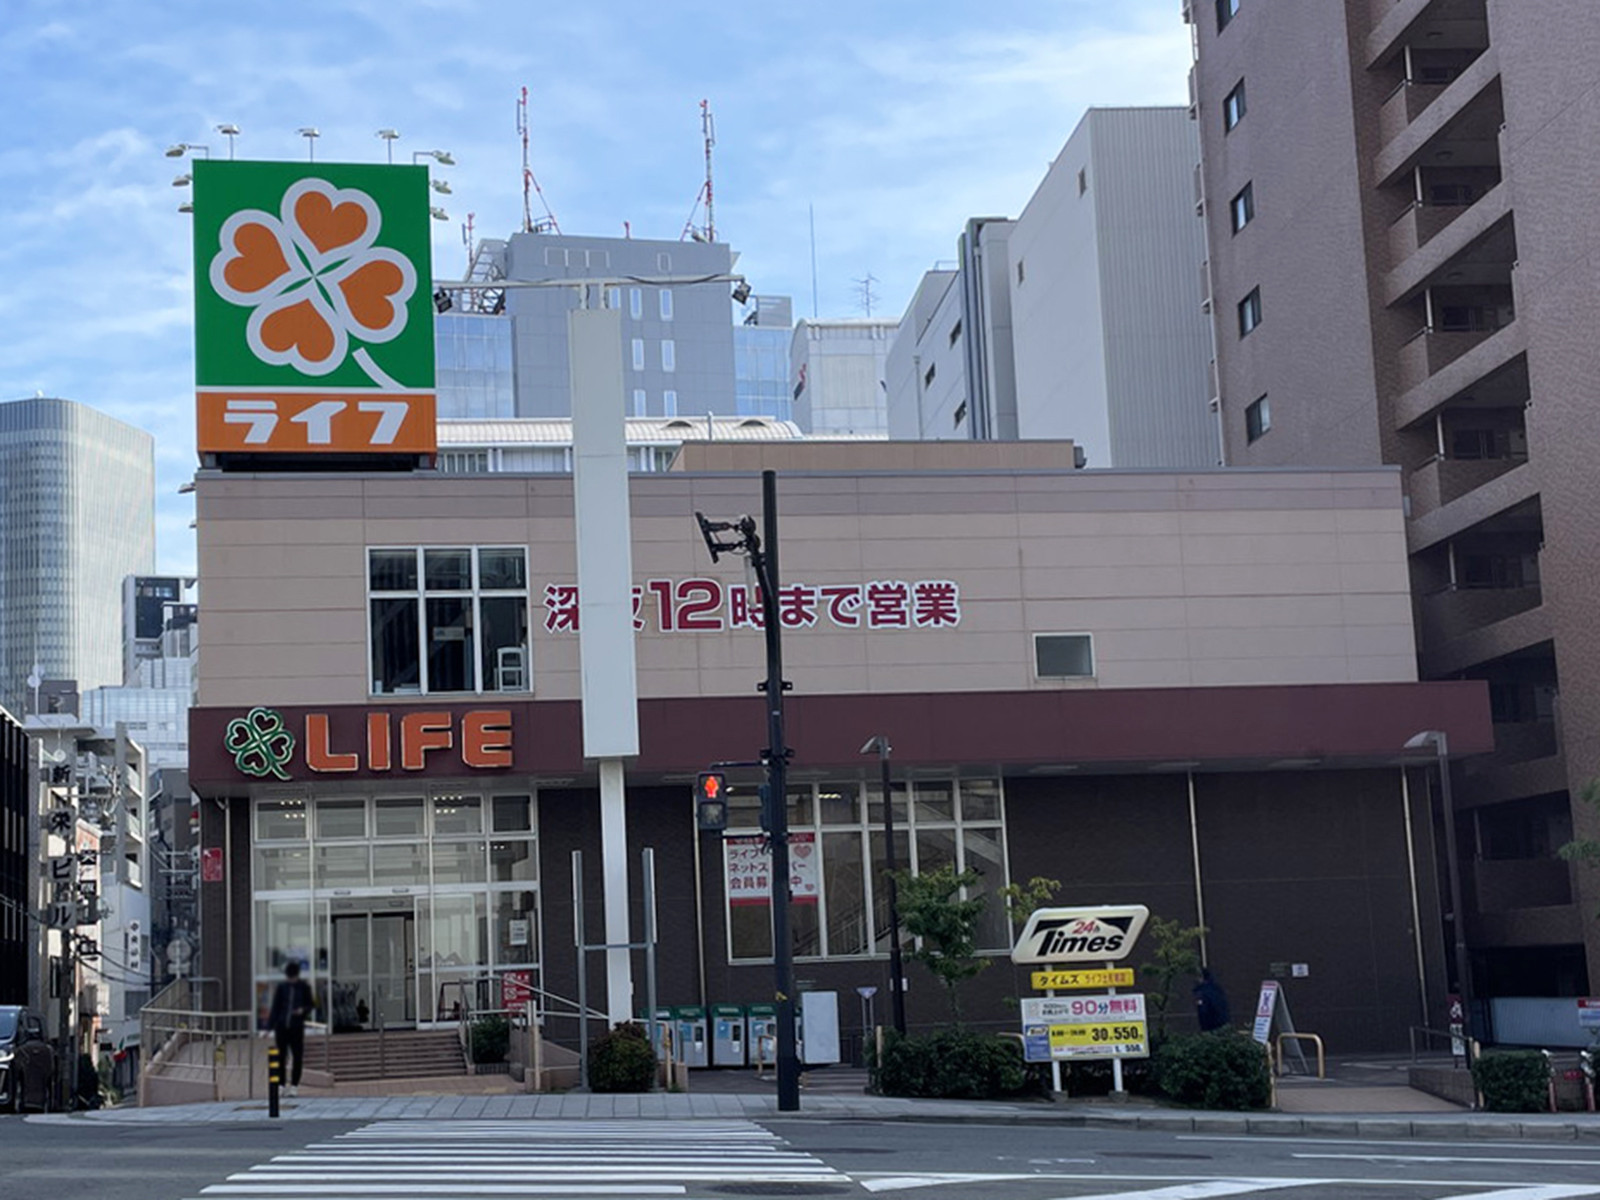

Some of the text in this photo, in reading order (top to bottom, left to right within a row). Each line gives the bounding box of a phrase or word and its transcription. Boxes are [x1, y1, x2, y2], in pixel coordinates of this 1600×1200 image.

[224, 400, 409, 444] ライフ
[543, 578, 961, 634] 深12時まで営業
[305, 709, 514, 773] LIFE
[731, 876, 802, 889] 会員募中
[1036, 929, 1124, 957] Times
